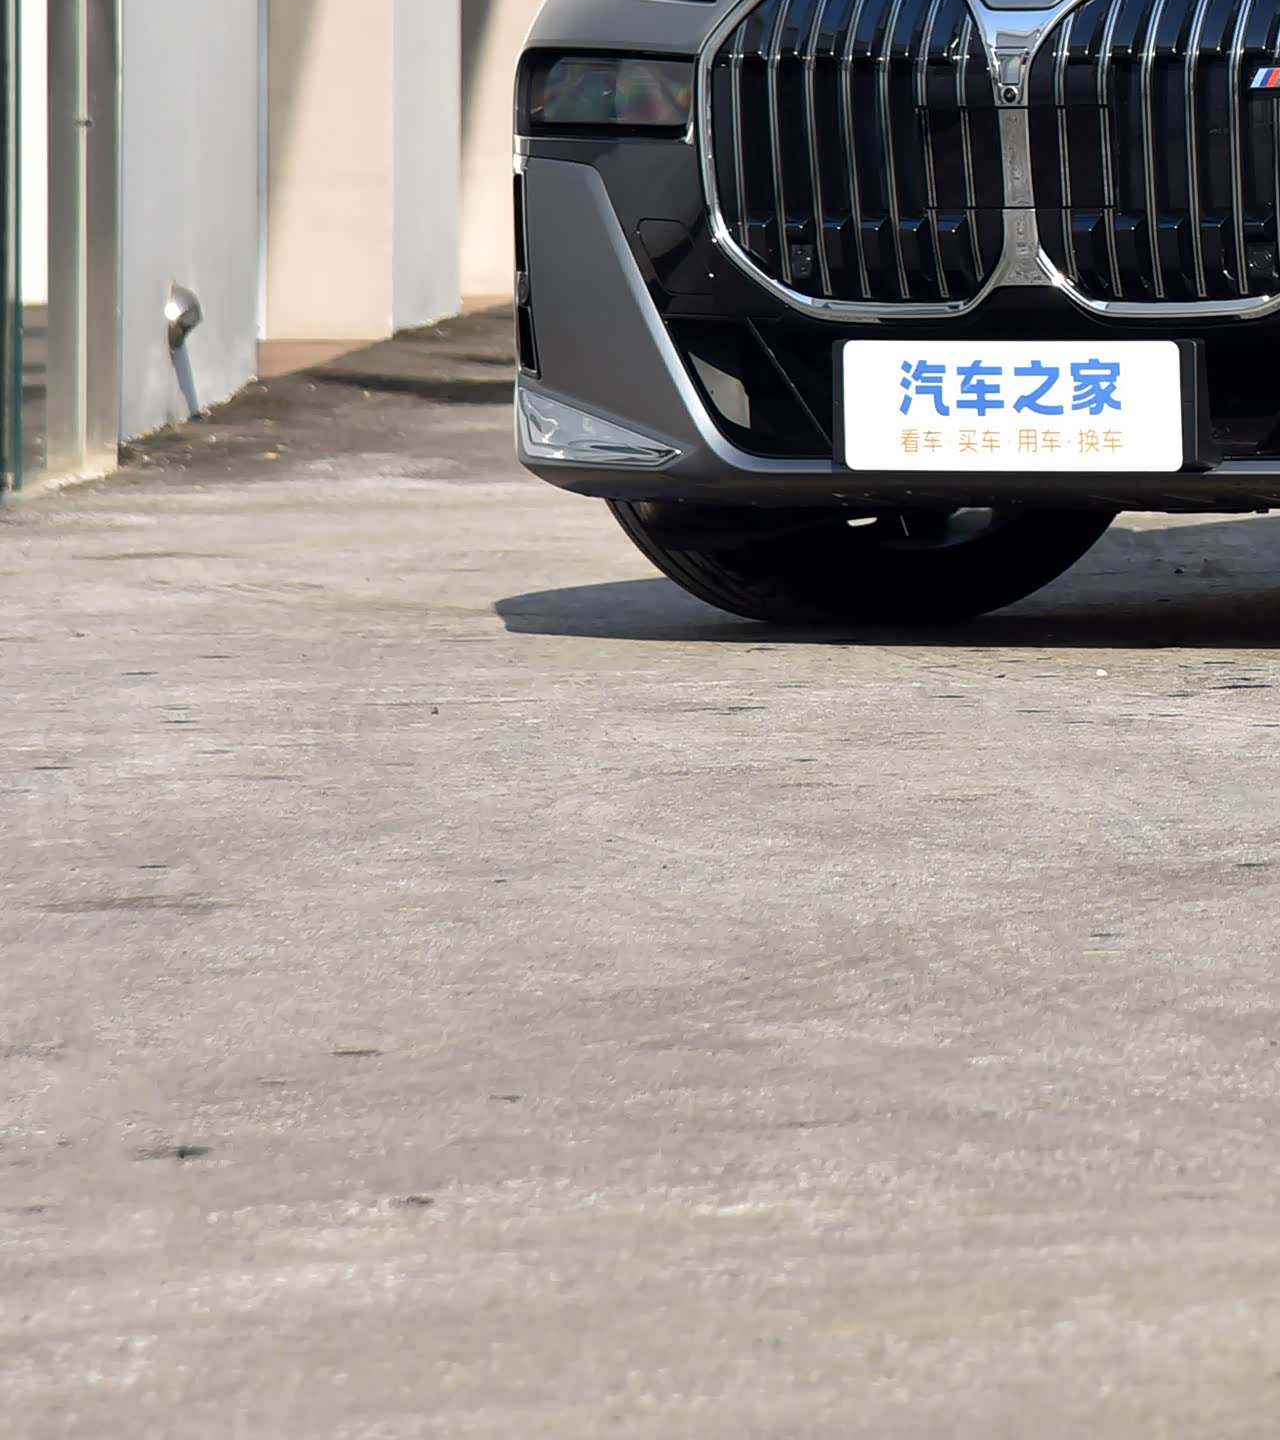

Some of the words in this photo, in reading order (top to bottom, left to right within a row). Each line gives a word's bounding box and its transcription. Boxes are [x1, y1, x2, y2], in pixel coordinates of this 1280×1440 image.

[899, 358, 1122, 417] 汽车之家
[900, 428, 943, 453] 看车
[959, 428, 1001, 453] 买车
[1018, 428, 1062, 453] 用车
[1077, 428, 1123, 453] 换车
